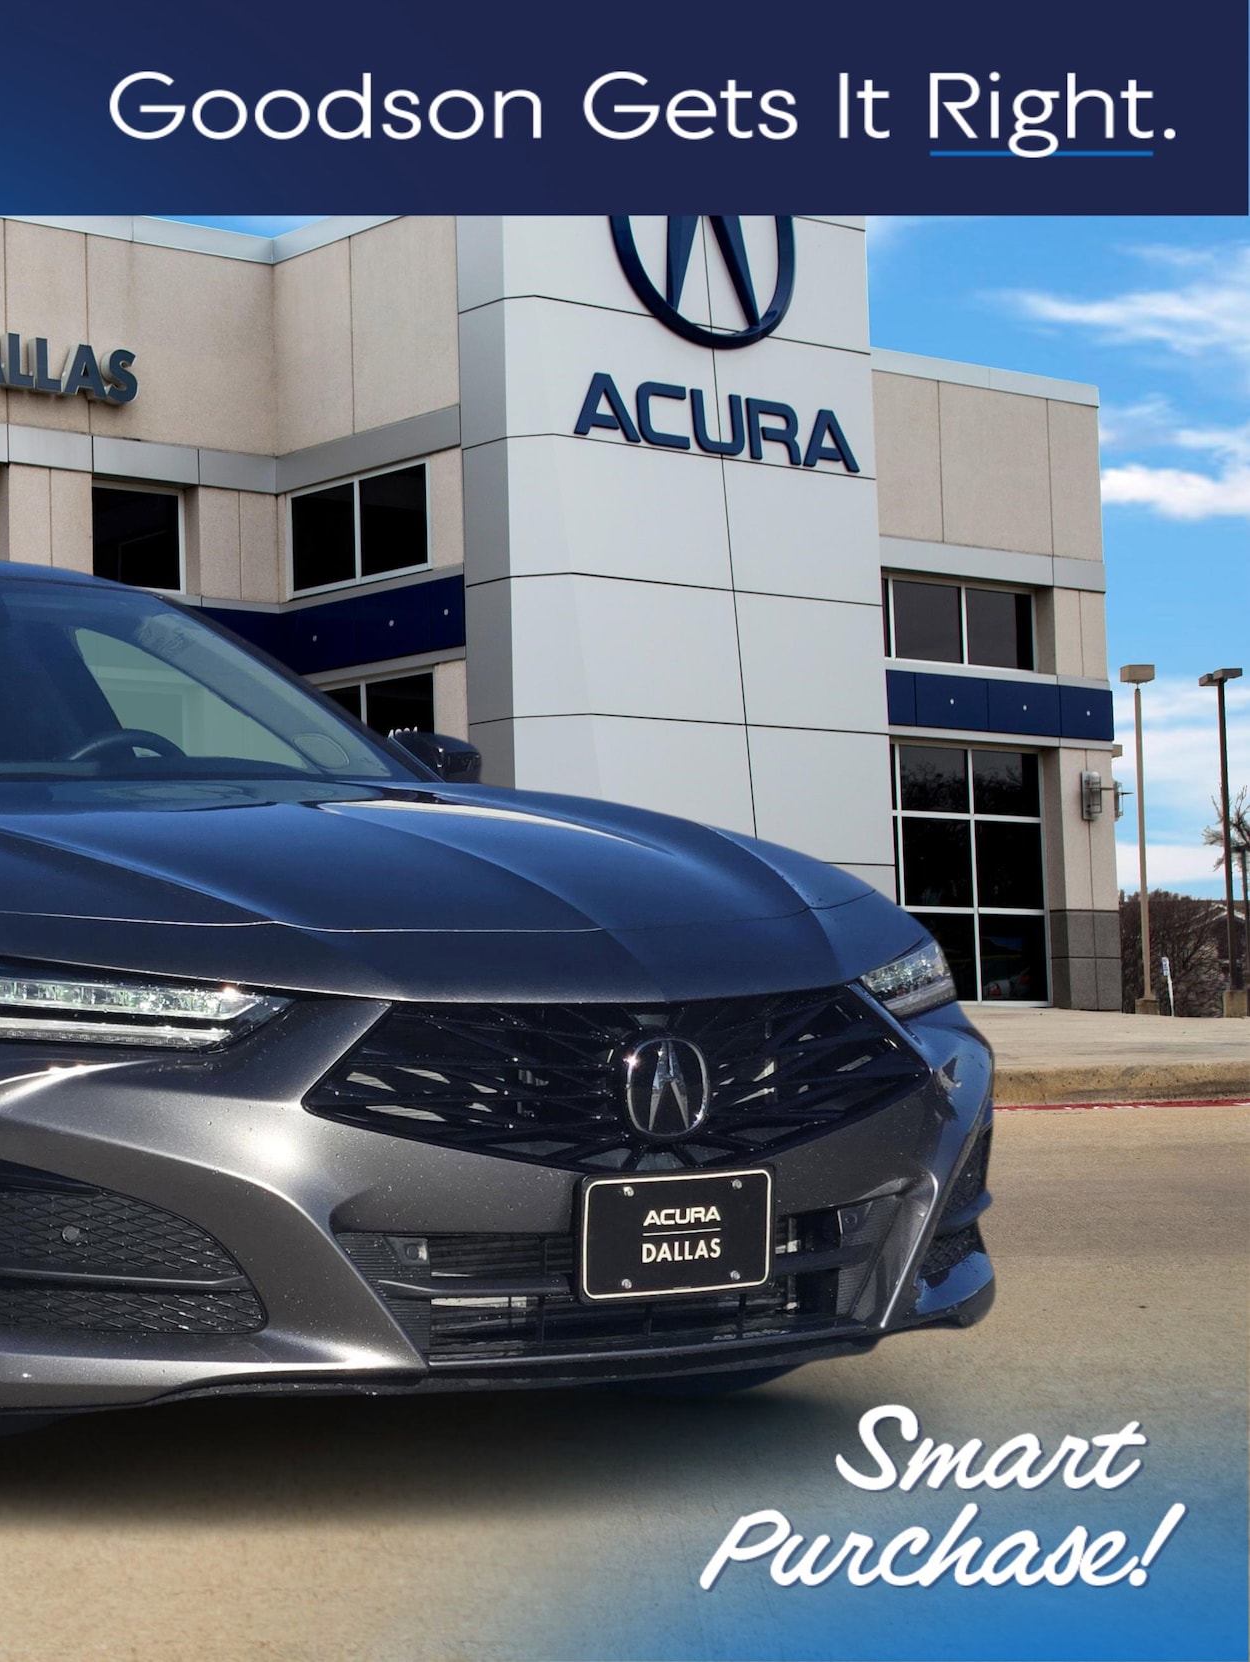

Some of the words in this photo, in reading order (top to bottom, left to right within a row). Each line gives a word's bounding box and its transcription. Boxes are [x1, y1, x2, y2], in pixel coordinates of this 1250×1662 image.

[574, 372, 860, 473] ACURA
[642, 1205, 722, 1227] ACURA
[641, 1237, 722, 1264] DALLAS
